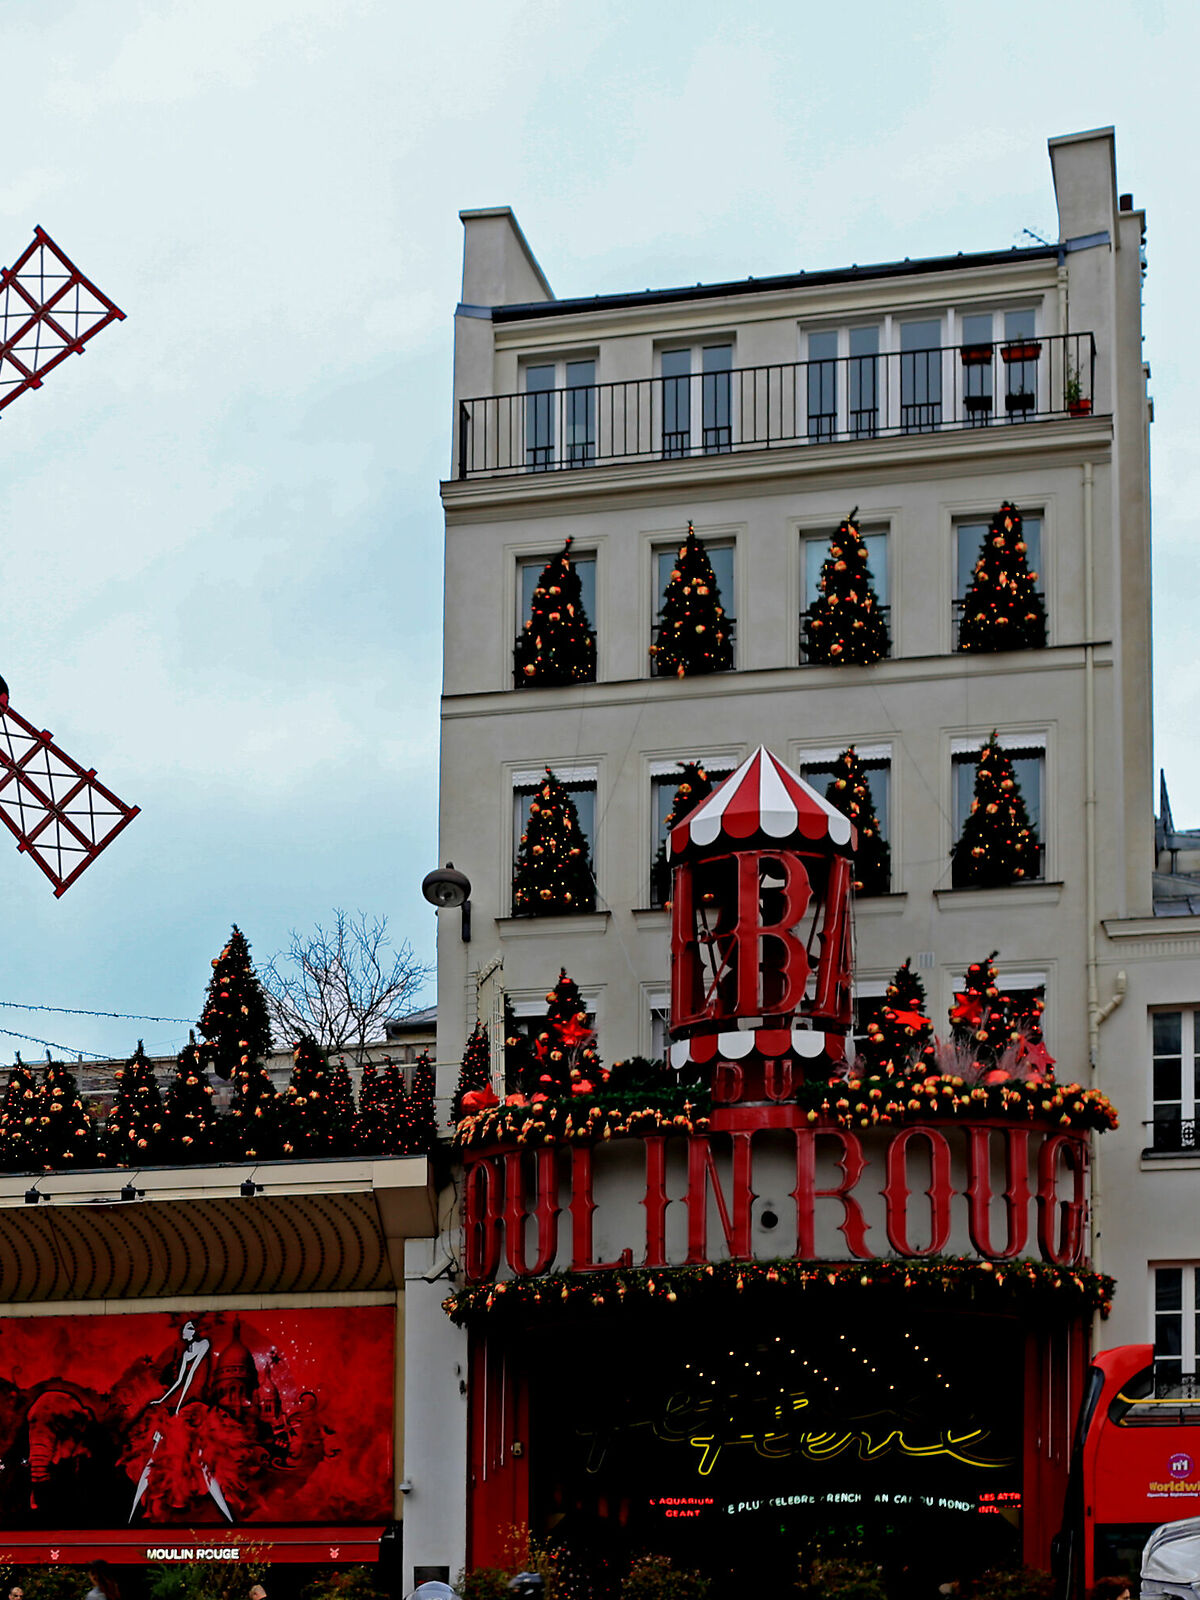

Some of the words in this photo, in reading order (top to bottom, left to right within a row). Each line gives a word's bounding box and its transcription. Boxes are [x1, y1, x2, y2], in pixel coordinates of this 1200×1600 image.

[716, 1059, 793, 1102] DU
[463, 1130, 760, 1285] OULIN
[790, 1126, 1091, 1266] ROUG
[738, 1500, 764, 1513] PLU
[820, 1493, 862, 1503] RENCH
[146, 1548, 194, 1560] MOULIN
[196, 1548, 240, 1560] ROUGE
